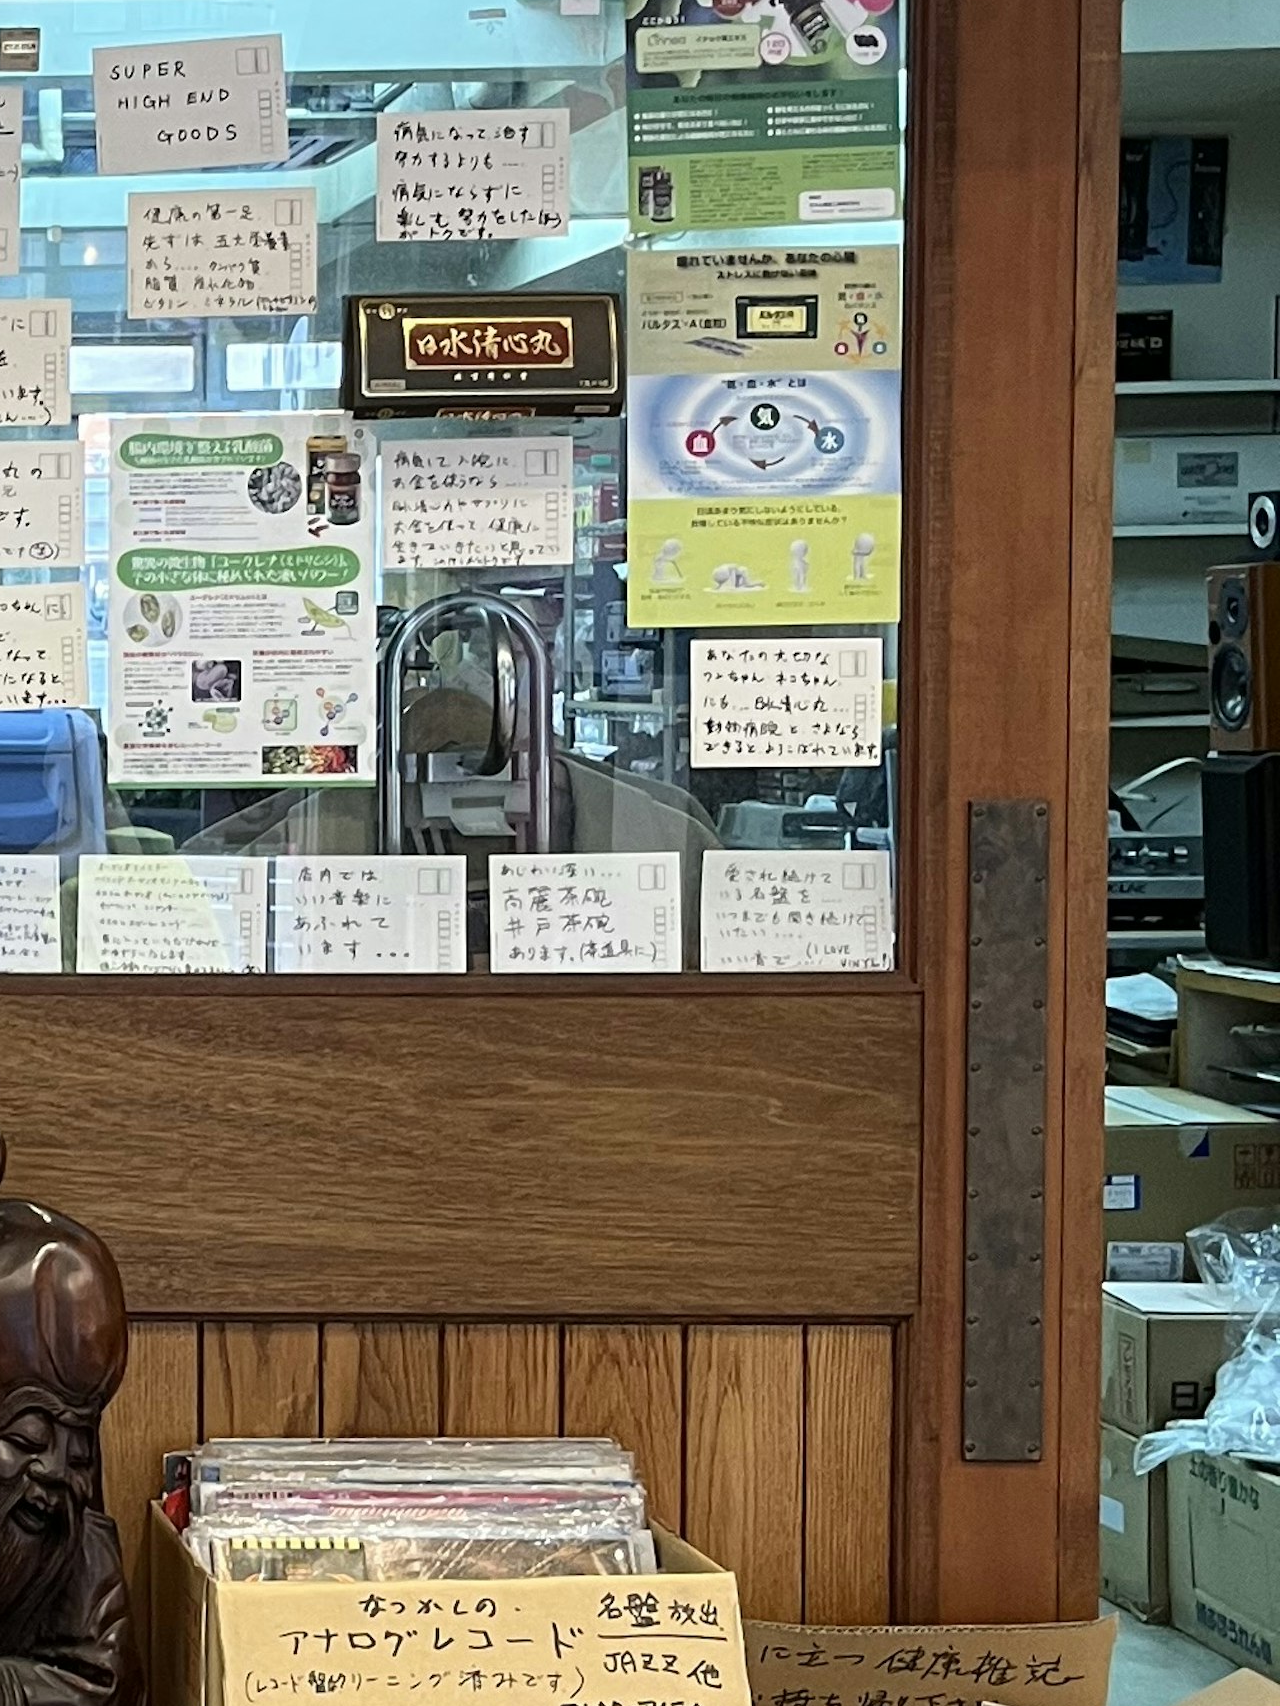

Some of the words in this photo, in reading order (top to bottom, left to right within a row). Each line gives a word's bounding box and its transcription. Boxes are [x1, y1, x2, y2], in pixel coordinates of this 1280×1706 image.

[110, 60, 187, 81] SUPER
[117, 94, 171, 110] HIGH
[186, 88, 230, 106] END
[157, 124, 238, 144] GOODS
[416, 327, 562, 358] 日水清心丸
[820, 430, 840, 451] 水
[824, 944, 850, 955] LOVE
[279, 1622, 584, 1658] アナログレコード
[603, 1652, 682, 1674] JAZZ
